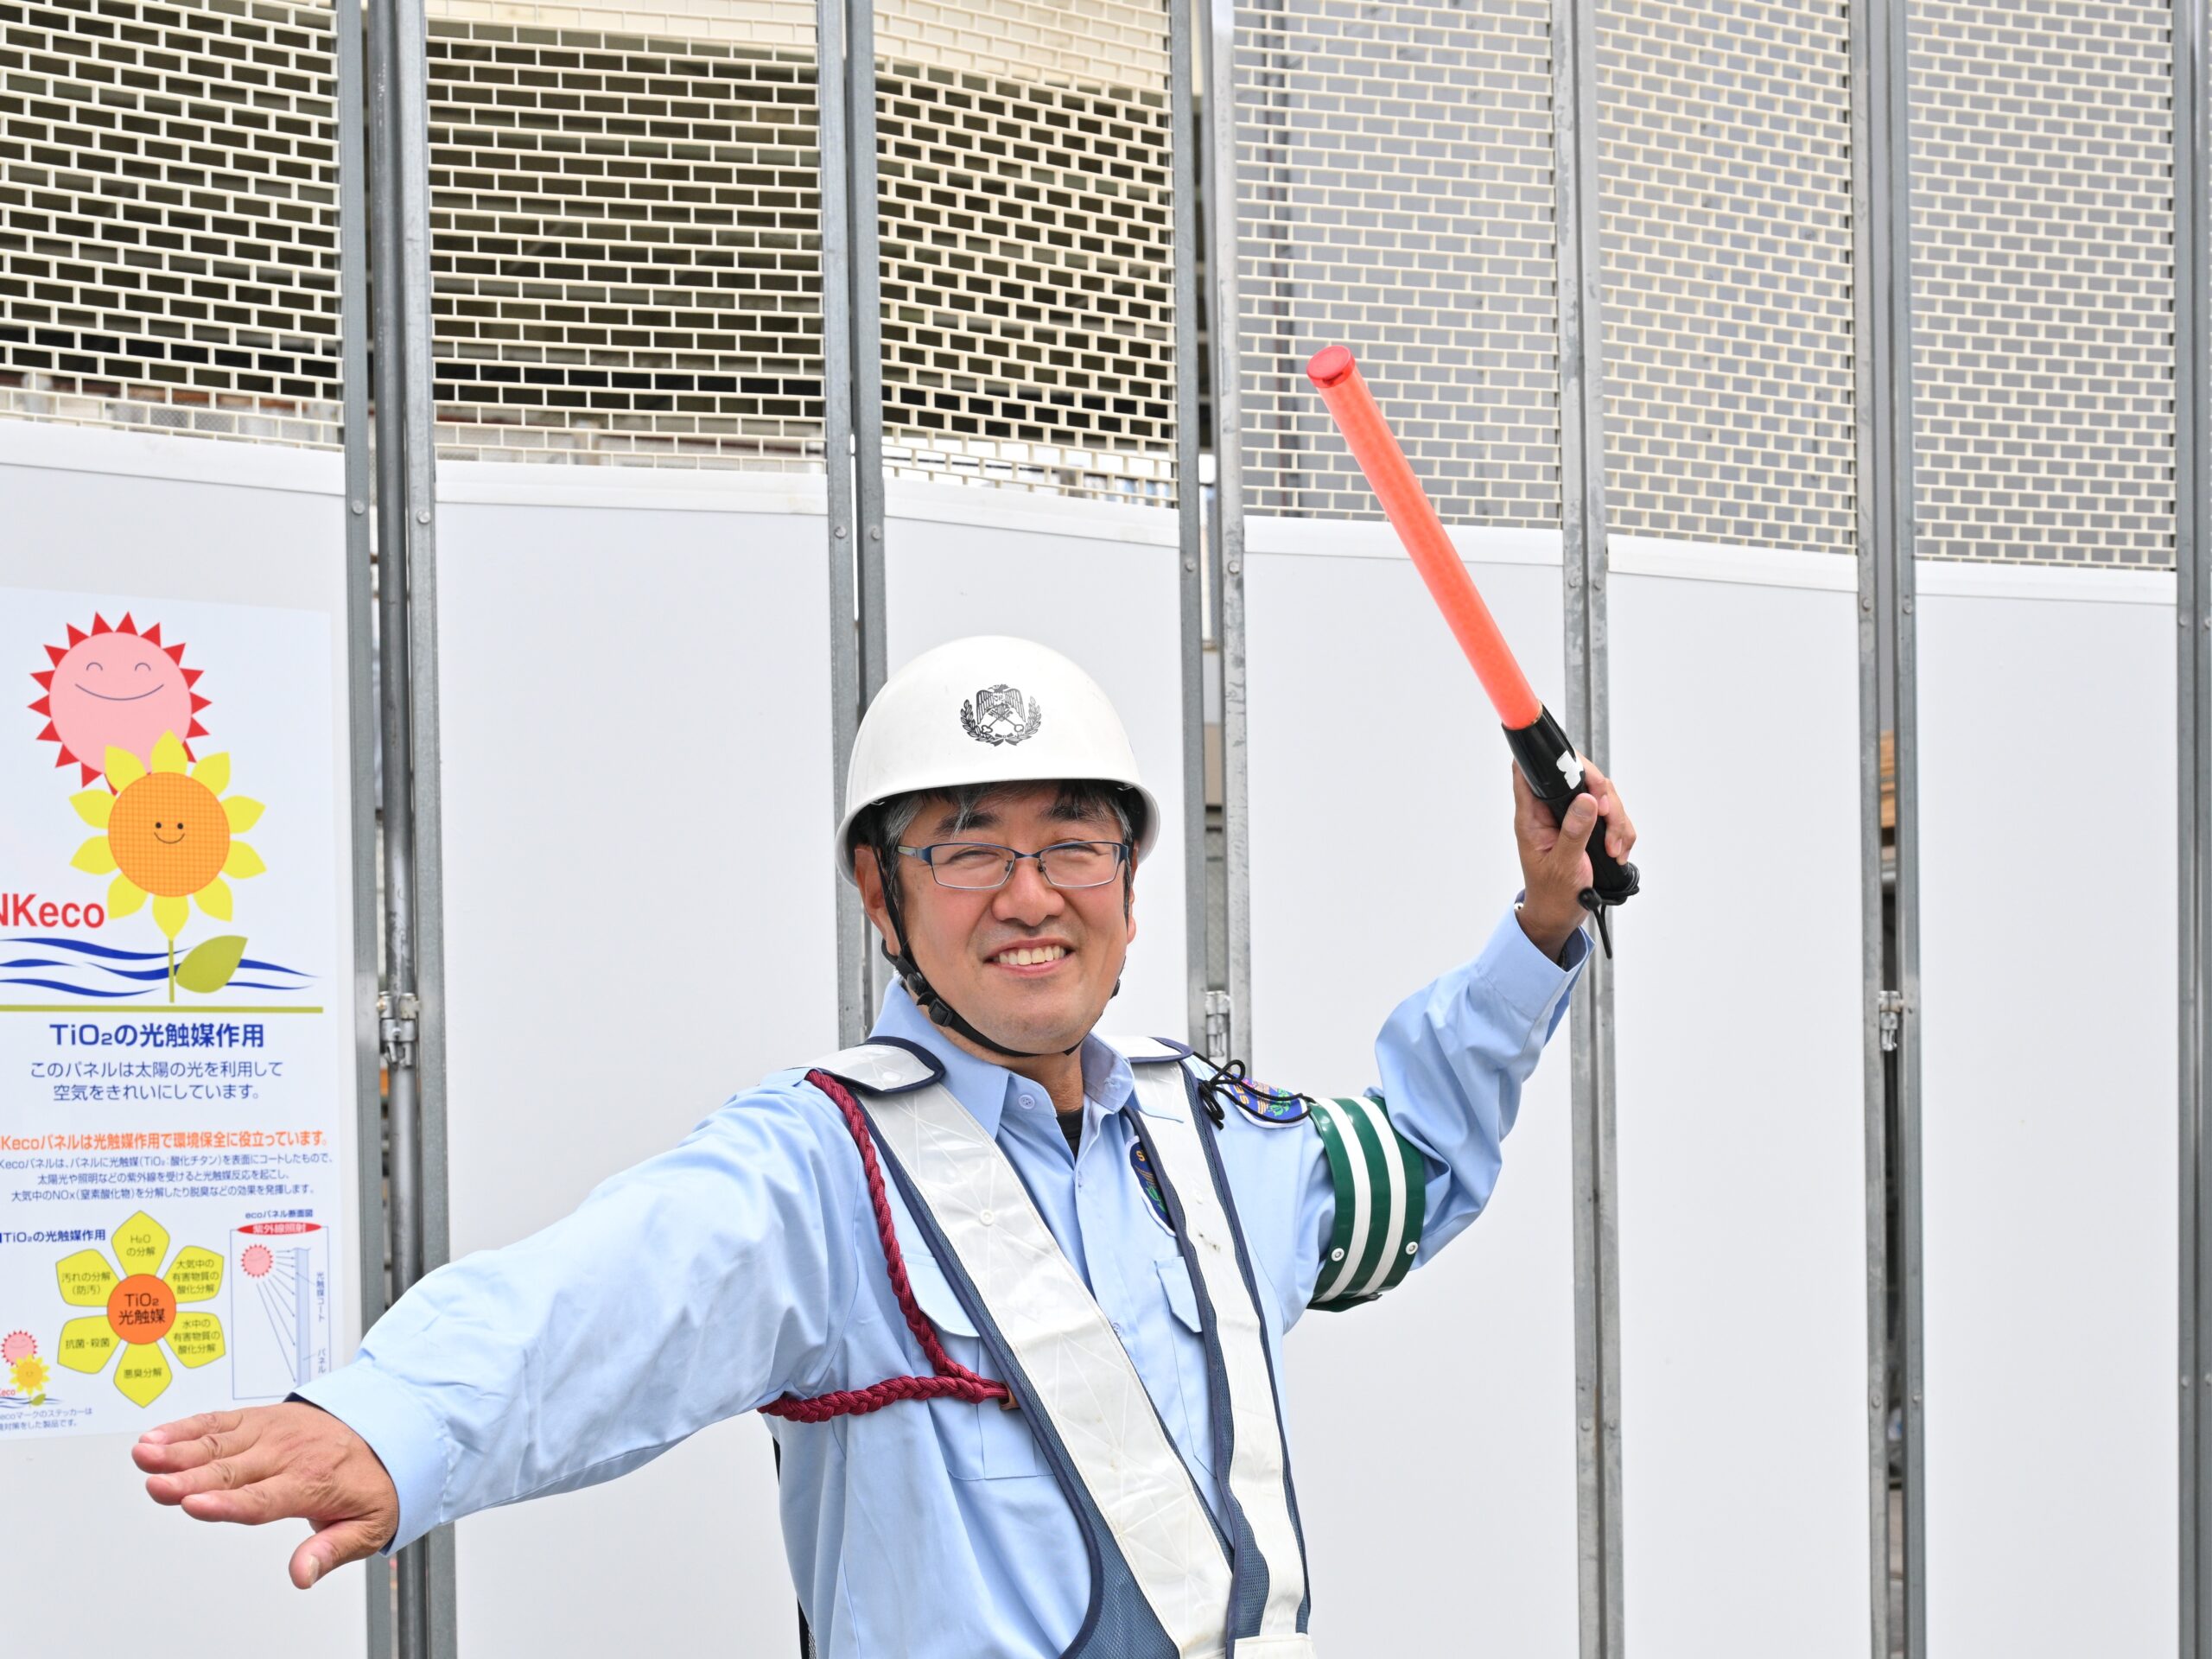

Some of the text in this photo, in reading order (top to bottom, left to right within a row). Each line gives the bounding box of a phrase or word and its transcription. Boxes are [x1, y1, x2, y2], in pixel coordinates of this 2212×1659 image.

[30, 1061, 283, 1078] このパネルは太陽の光を利用して
[53, 1084, 259, 1102] 空気をきれいにしています。
[126, 1247, 156, 1257] の分解
[176, 1259, 215, 1269] 大気中の
[61, 1272, 111, 1283] 汚れの分解
[173, 1271, 219, 1282] 有害物質の
[177, 1284, 215, 1295] 酸化分解
[118, 1308, 165, 1325] 光触媒
[182, 1319, 211, 1329] 水中の
[174, 1332, 220, 1342] 有害物質の
[178, 1344, 216, 1355] 酸化分解
[124, 1368, 162, 1379] 悪臭分解
[0, 1389, 16, 1397] eco
